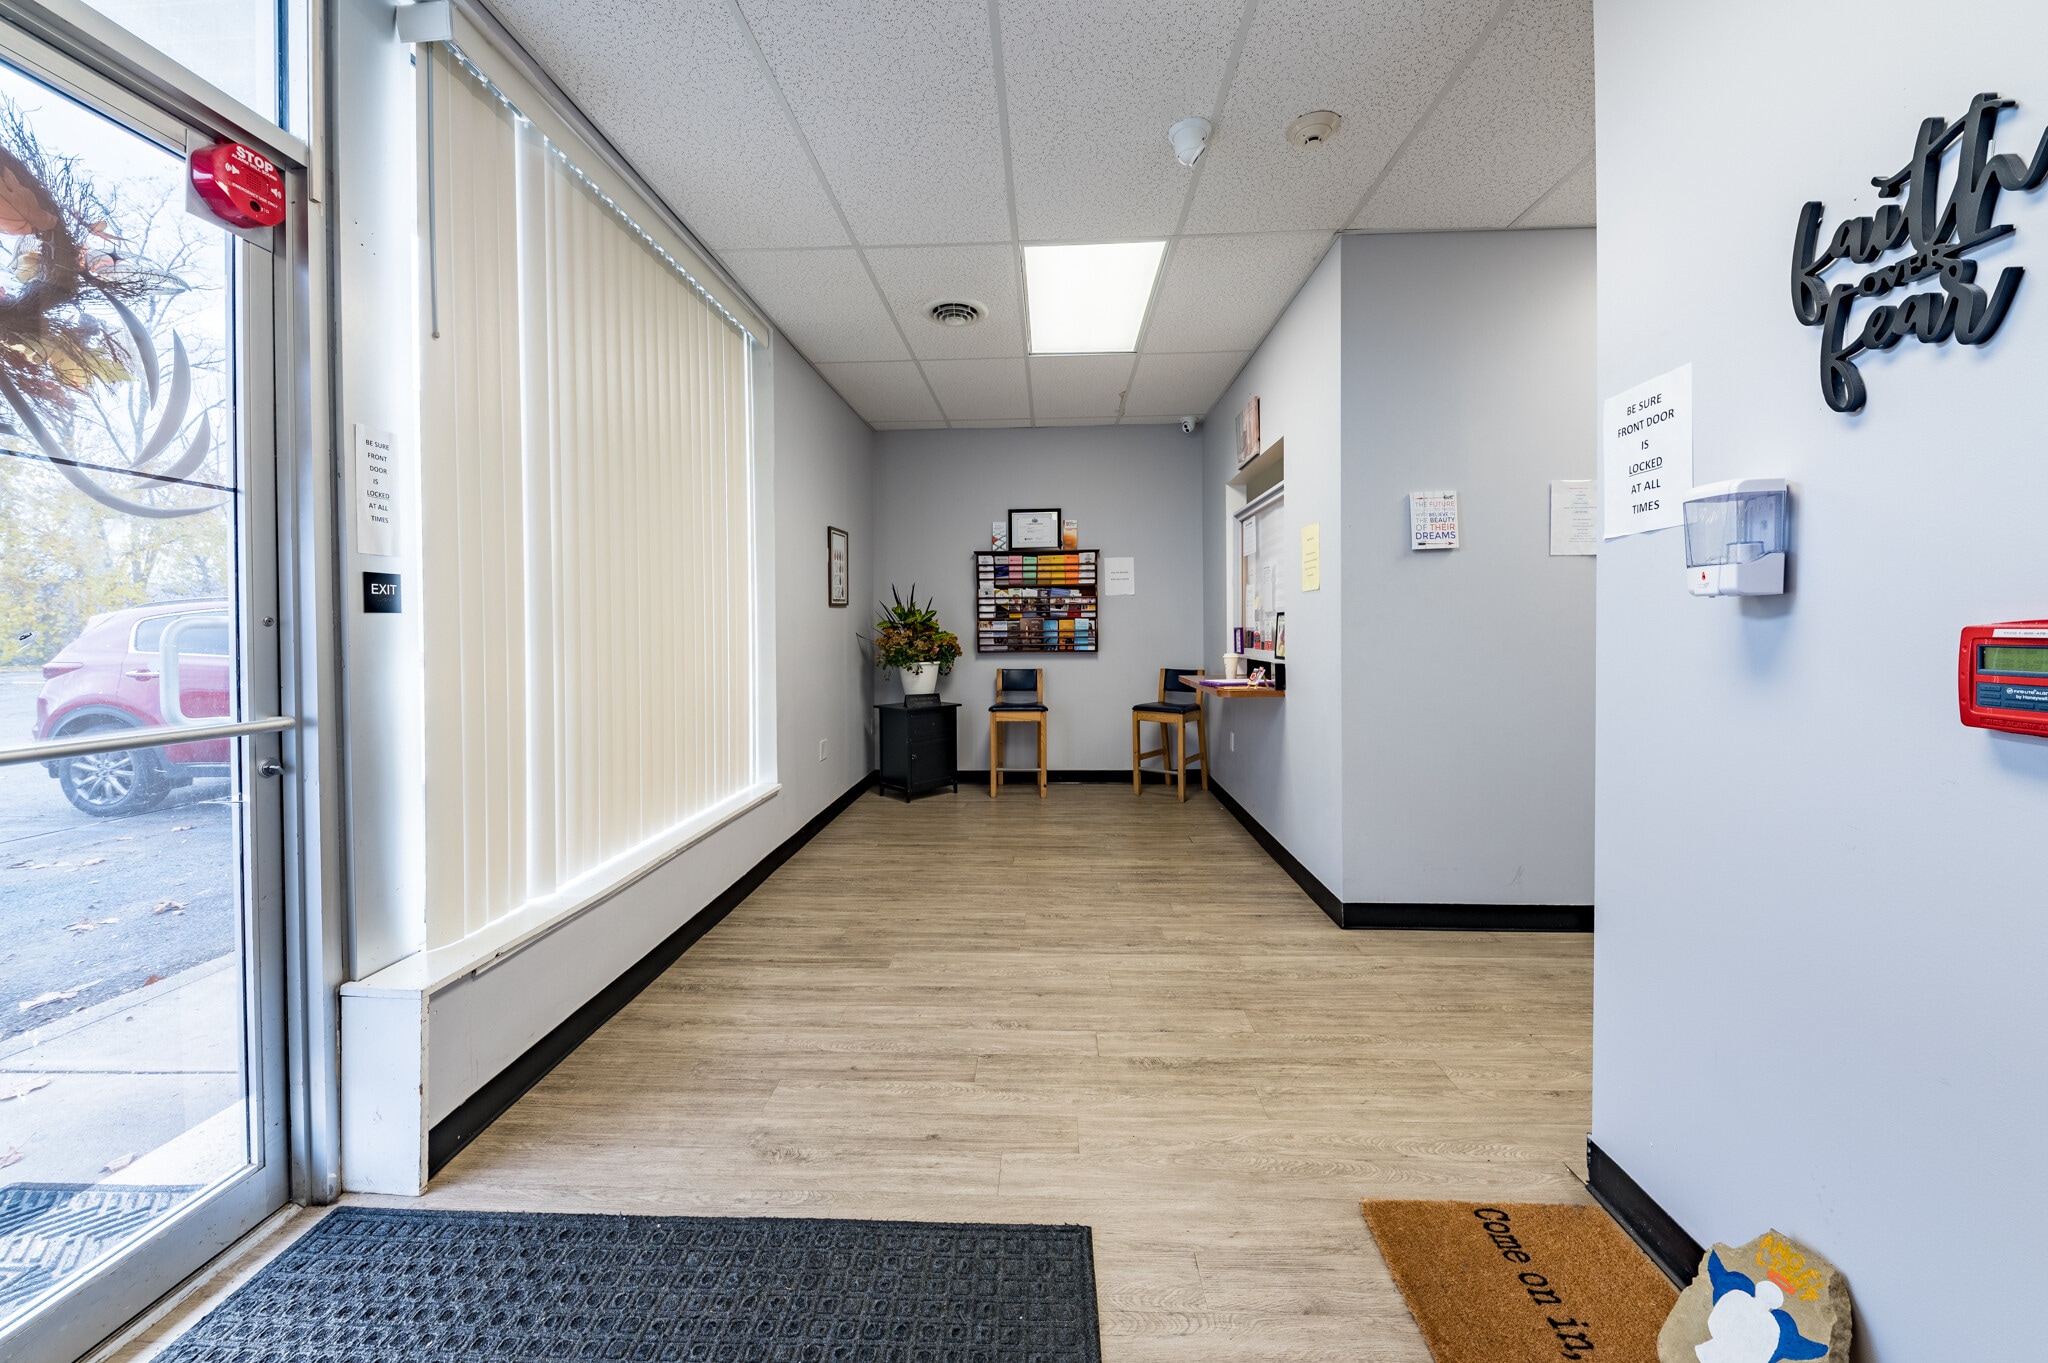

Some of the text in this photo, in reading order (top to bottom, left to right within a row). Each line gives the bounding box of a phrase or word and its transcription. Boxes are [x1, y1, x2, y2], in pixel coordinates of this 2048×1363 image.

[236, 145, 274, 172] STOP
[1791, 92, 2048, 326] faith
[1859, 244, 1958, 297] OVER
[1820, 259, 2026, 413] fear
[1626, 393, 1662, 416] BE SURE
[1617, 408, 1675, 439] FRONT DOOR
[365, 439, 390, 451] BE SURE
[1641, 439, 1649, 451] IS
[367, 452, 387, 462] FRONT
[369, 465, 388, 475] DOOR
[1628, 456, 1663, 477] LOCKED
[1631, 478, 1661, 495] AT ALL
[366, 490, 390, 500] LOCKED
[1632, 499, 1660, 515] TIMES
[371, 515, 389, 524] TIMES
[1416, 531, 1456, 540] DREAMS
[371, 583, 397, 595] EXIT
[1474, 1208, 1595, 1360] Come on in,
